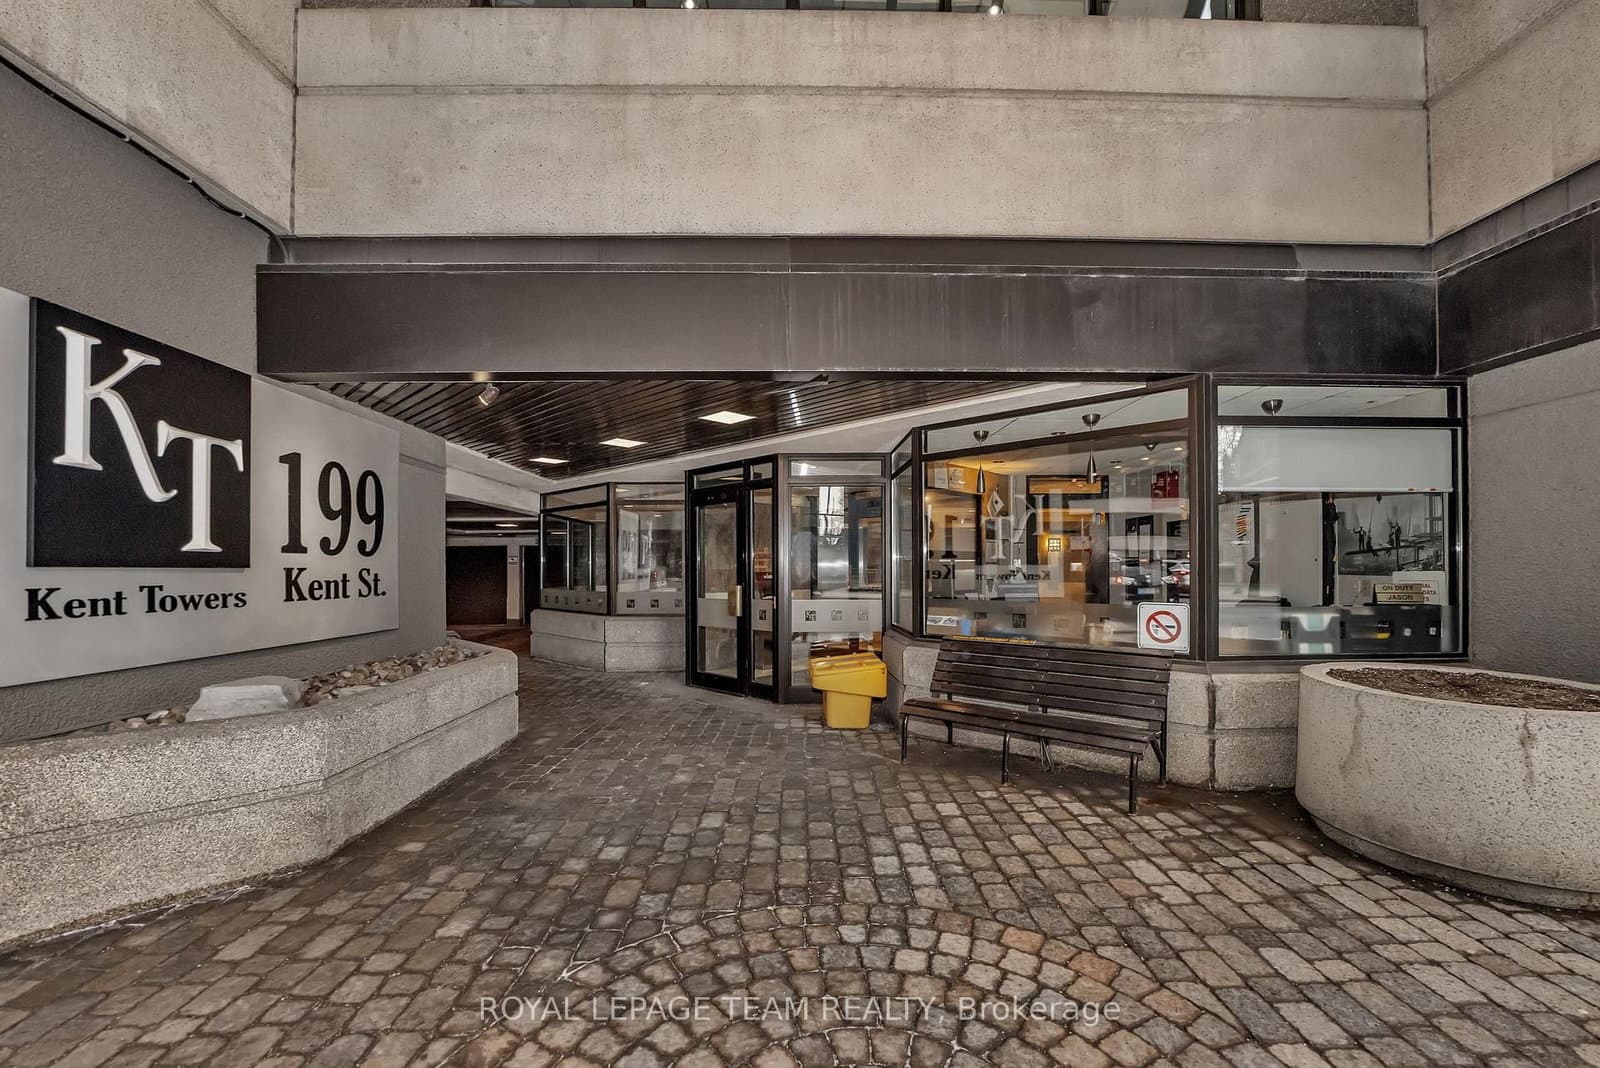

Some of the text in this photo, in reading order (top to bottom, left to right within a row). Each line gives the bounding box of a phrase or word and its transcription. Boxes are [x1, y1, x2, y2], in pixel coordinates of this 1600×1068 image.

[52, 325, 245, 553] KT
[278, 451, 385, 557] 199
[24, 585, 247, 622] Kent Towers
[283, 567, 387, 602] Kent St.
